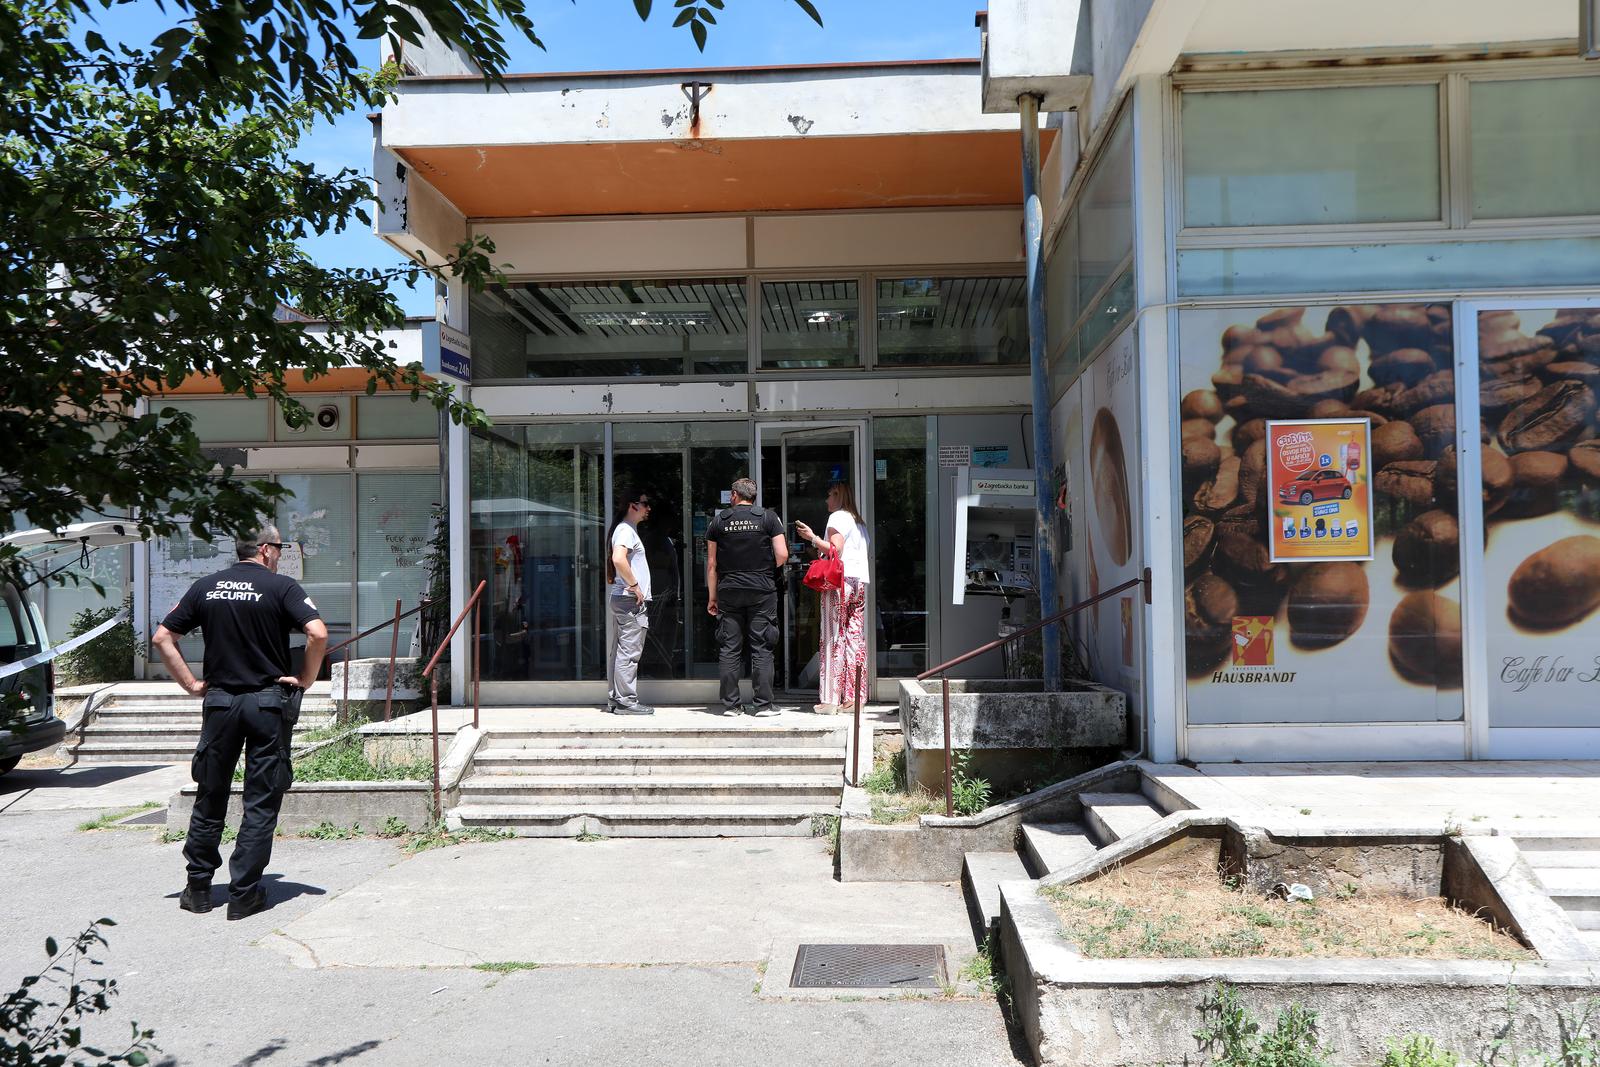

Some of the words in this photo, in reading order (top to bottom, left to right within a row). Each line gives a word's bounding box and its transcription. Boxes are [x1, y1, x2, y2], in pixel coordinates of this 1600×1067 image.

[458, 361, 470, 377] 24h
[1277, 432, 1313, 447] CEDEVITA
[1321, 456, 1330, 464] 1x
[215, 580, 255, 591] SOKOL
[205, 590, 263, 602] SECURITY
[1544, 655, 1574, 682] bar
[1212, 671, 1297, 683] HAUSBRANDT
